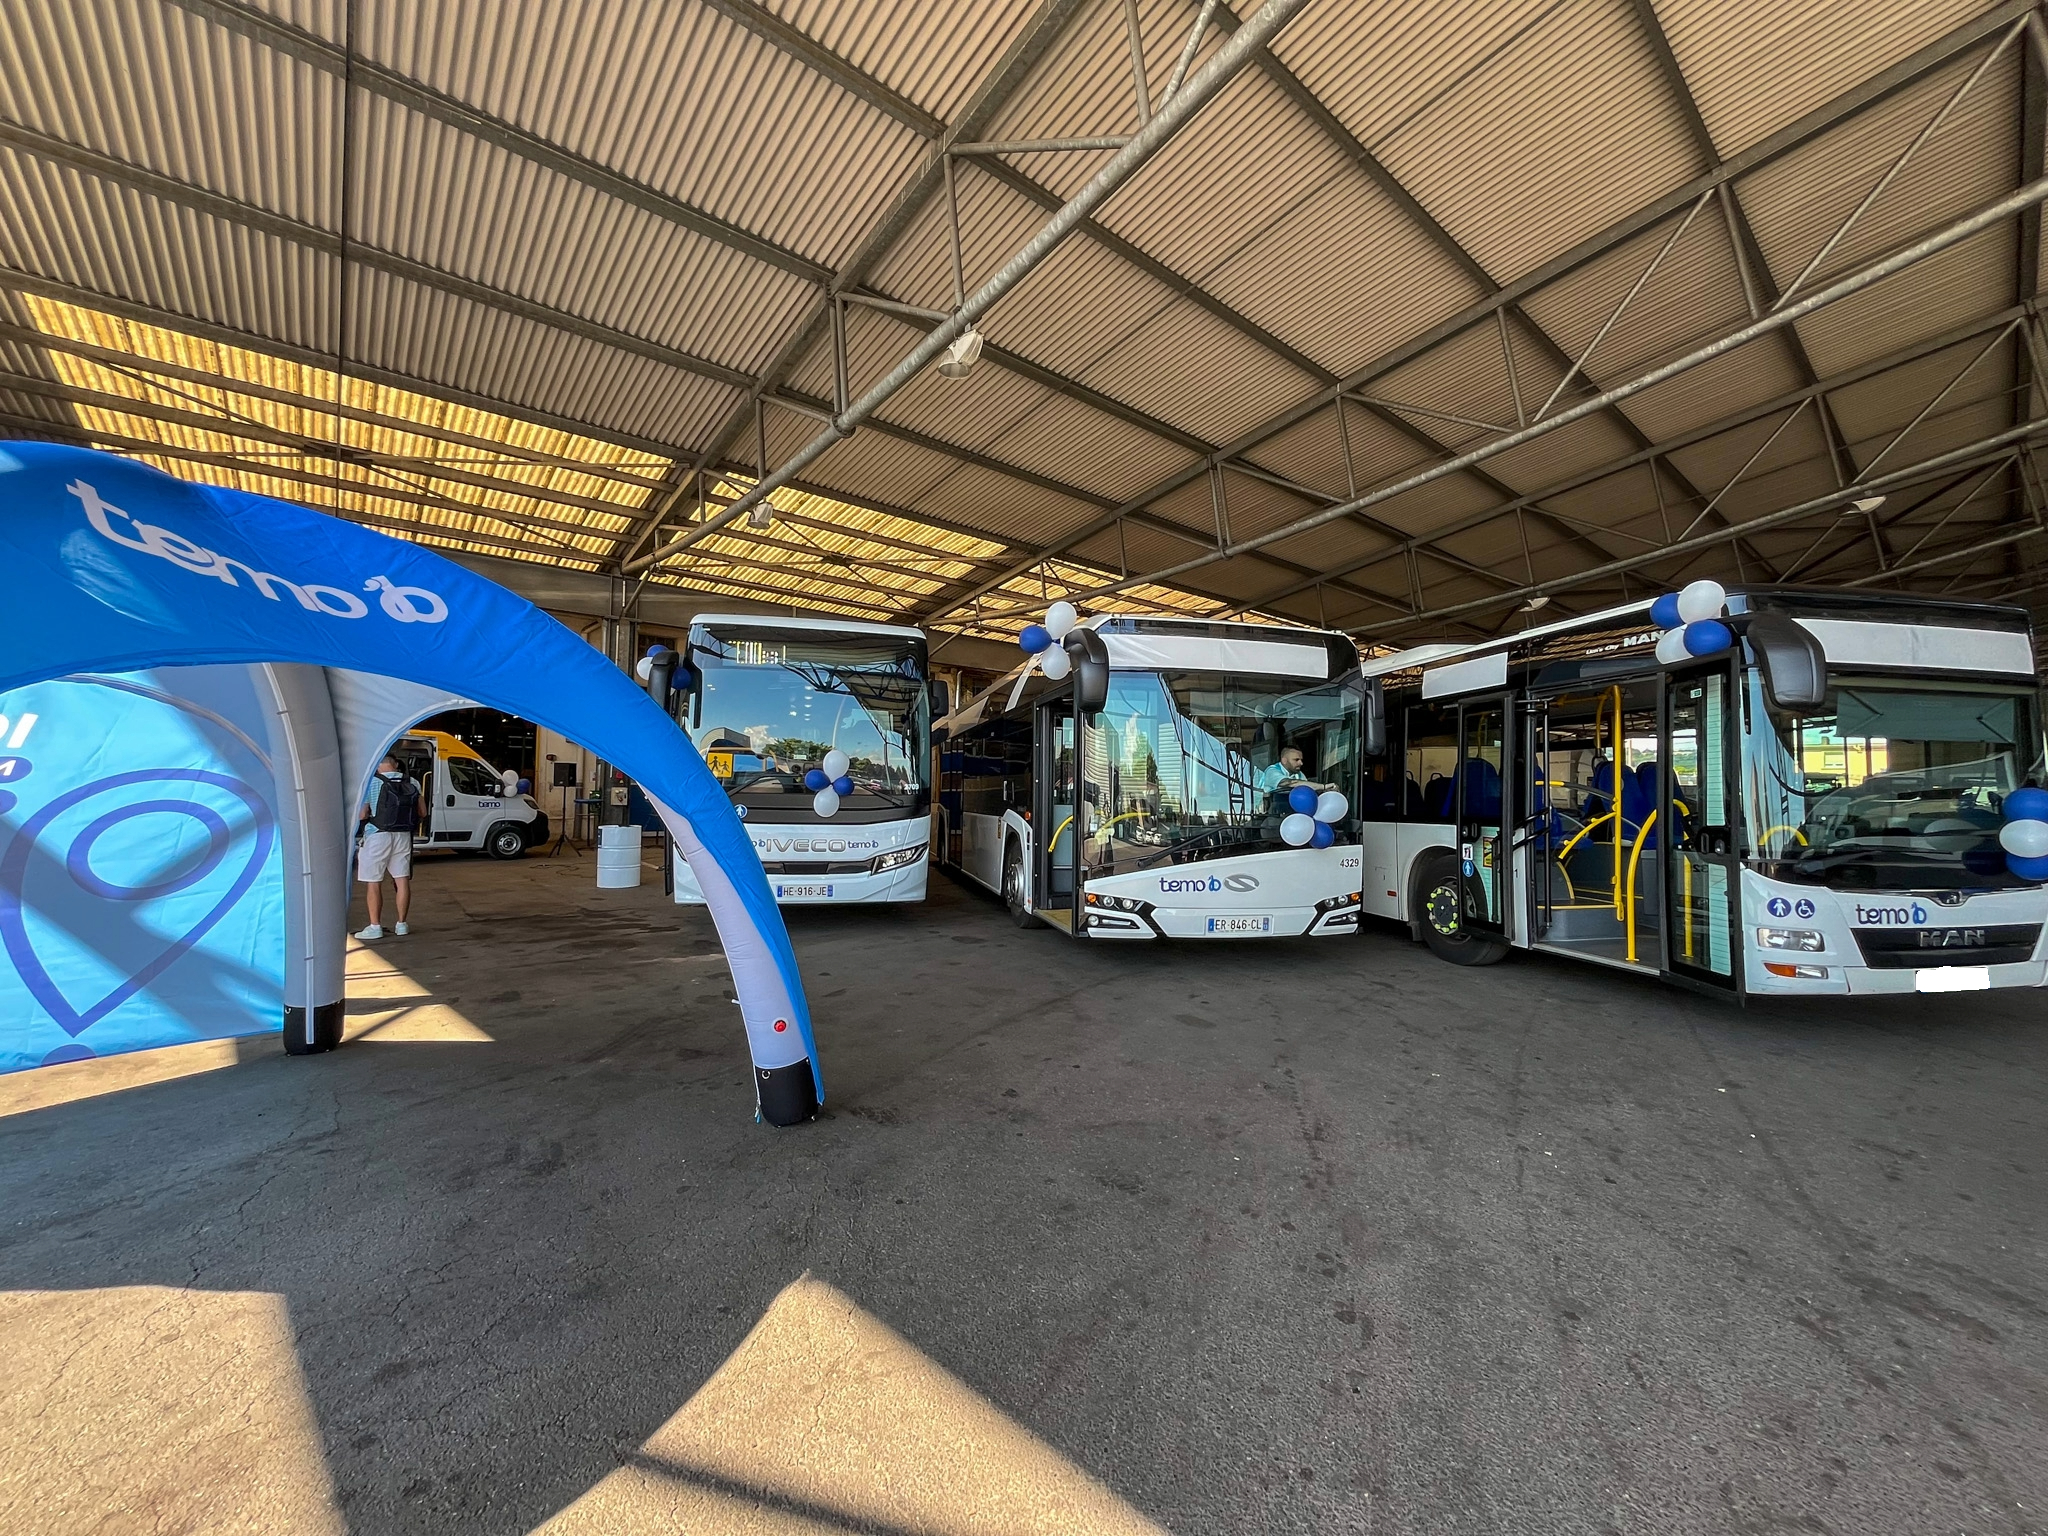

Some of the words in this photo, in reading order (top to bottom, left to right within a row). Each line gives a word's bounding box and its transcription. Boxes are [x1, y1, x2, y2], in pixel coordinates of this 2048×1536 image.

[66, 479, 368, 618] temo
[1623, 630, 1665, 647] MAN
[766, 839, 847, 852] IVECO
[1339, 859, 1360, 868] 4329
[783, 887, 827, 896] HE-916-JE
[1159, 877, 1206, 892] temo
[1855, 904, 1909, 924] temo
[1215, 918, 1261, 930] ER-846-CL
[1920, 930, 1985, 947] MAN
